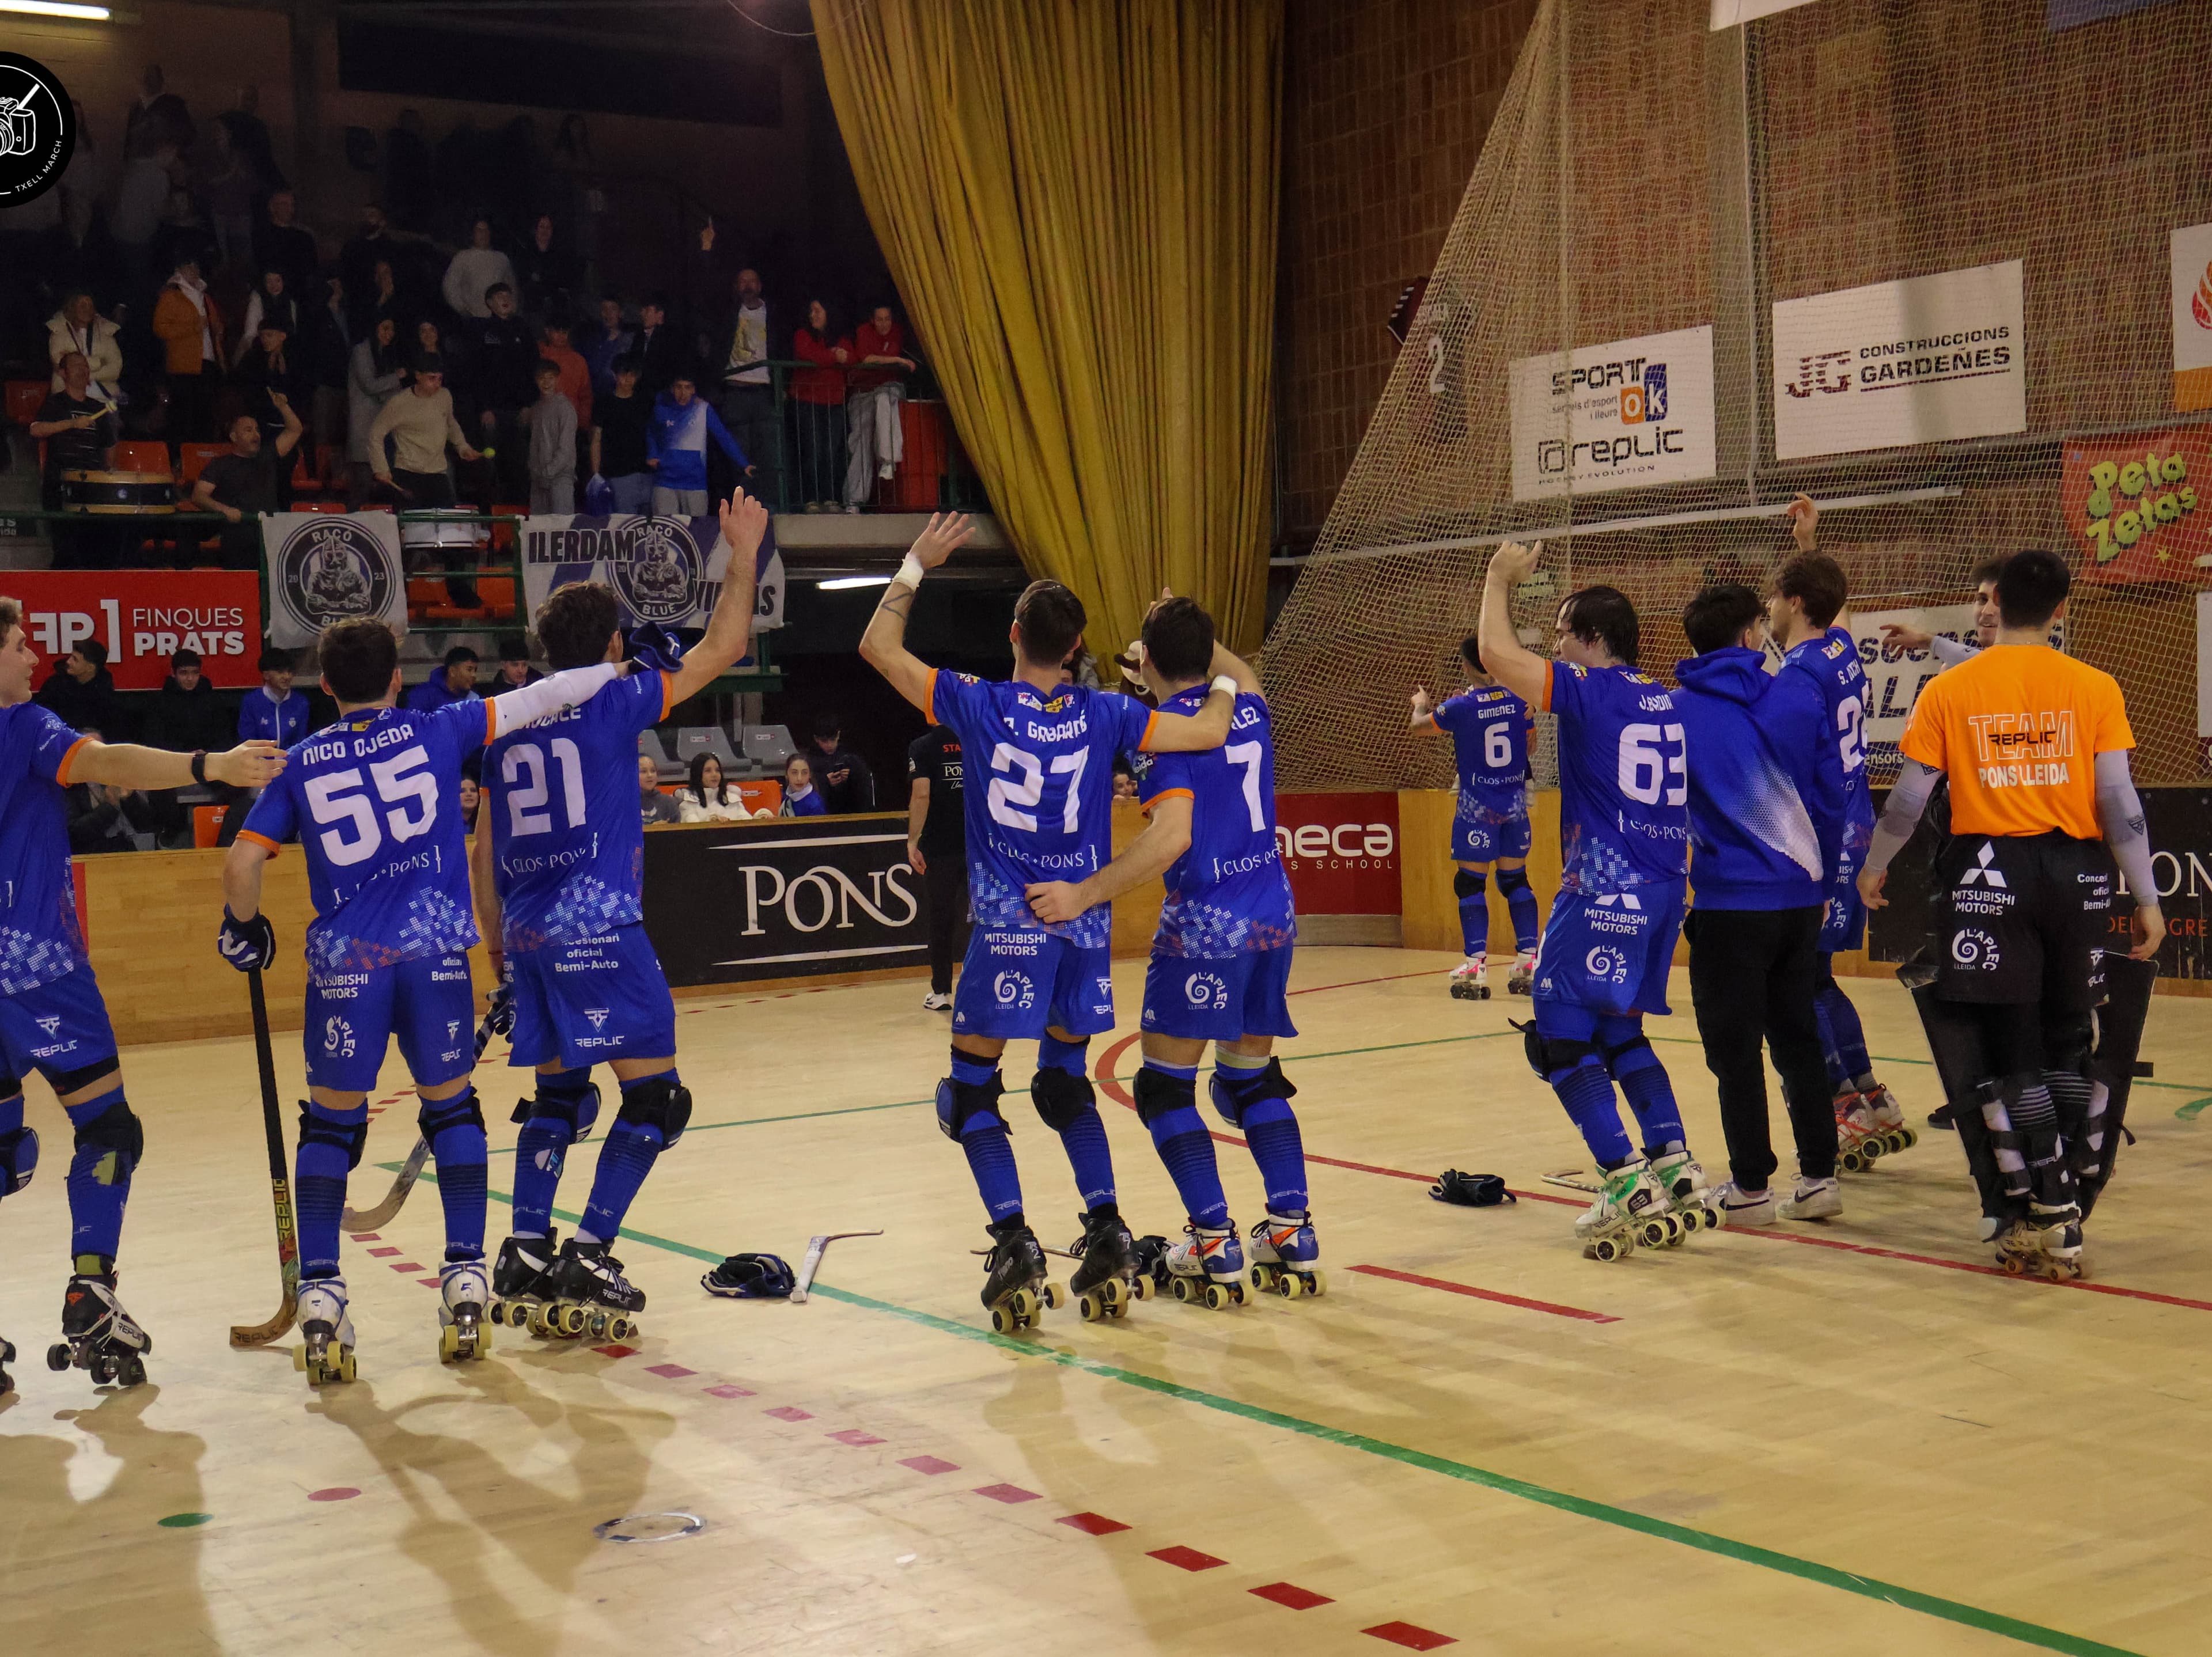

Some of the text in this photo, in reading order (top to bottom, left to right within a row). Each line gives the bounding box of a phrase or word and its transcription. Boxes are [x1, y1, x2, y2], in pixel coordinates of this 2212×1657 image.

[1860, 326, 2010, 359] CONSTRUCCIONS
[1571, 426, 1684, 467] replic
[1588, 464, 1656, 479] EVOLUTION
[311, 528, 353, 543] RACÓ
[638, 524, 673, 539] RACÓ
[528, 529, 635, 564] ILERDAM
[642, 603, 676, 616] BLUE
[132, 608, 244, 630] FINQUES
[134, 631, 245, 657] PRATS
[1477, 703, 1517, 720] GIMENEZ
[1484, 721, 1513, 768] 6
[1968, 710, 2074, 762] TEAM
[1988, 730, 2056, 746] REPLIC
[302, 723, 415, 767] NICO OJEDA
[942, 743, 962, 753] STA
[1618, 722, 1687, 806] 63
[1864, 751, 1904, 765] ensors
[944, 765, 964, 777] PON
[1978, 763, 2070, 788] PONS LLEIDA
[501, 737, 588, 837] 21
[987, 742, 1090, 834] 27
[1224, 740, 1266, 833] 7
[1477, 776, 1501, 786] CLOS
[304, 744, 440, 867] 55
[1275, 823, 1394, 858] neca
[389, 851, 430, 879] PONS
[1040, 852, 1085, 869] PONS
[1223, 854, 1262, 876] CLOS
[1316, 859, 1393, 869] SCHOOL
[2115, 851, 2212, 897] ON
[738, 863, 918, 936] PONS
[1952, 889, 2015, 906] MITSUBISHI
[1584, 907, 1648, 925] MITSUBISHI
[1955, 901, 2004, 916] MOTORS
[1590, 920, 1638, 935] MOTORS
[984, 933, 1047, 944] MITSUBISHI
[567, 948, 603, 958] oficial
[990, 945, 1037, 956] MOTORS
[1965, 927, 2000, 972] L'APLEC
[554, 960, 619, 972] Bemi-Auto
[1601, 944, 1627, 984] L'APLEC
[1586, 975, 1607, 983] LLEIDA
[321, 987, 358, 999] MOTORS
[1005, 969, 1035, 1009] L'APLEC
[1198, 971, 1228, 1010] L'APLEC
[29, 1039, 78, 1058] REPLIC
[574, 1035, 625, 1048] REPLIC
[994, 1199, 1022, 1210] REPL
[1200, 1201, 1228, 1215] REPL
[1630, 1193, 1649, 1209] 63
[1593, 1210, 1622, 1230] REPLI
[603, 1288, 632, 1304] REPLIC
